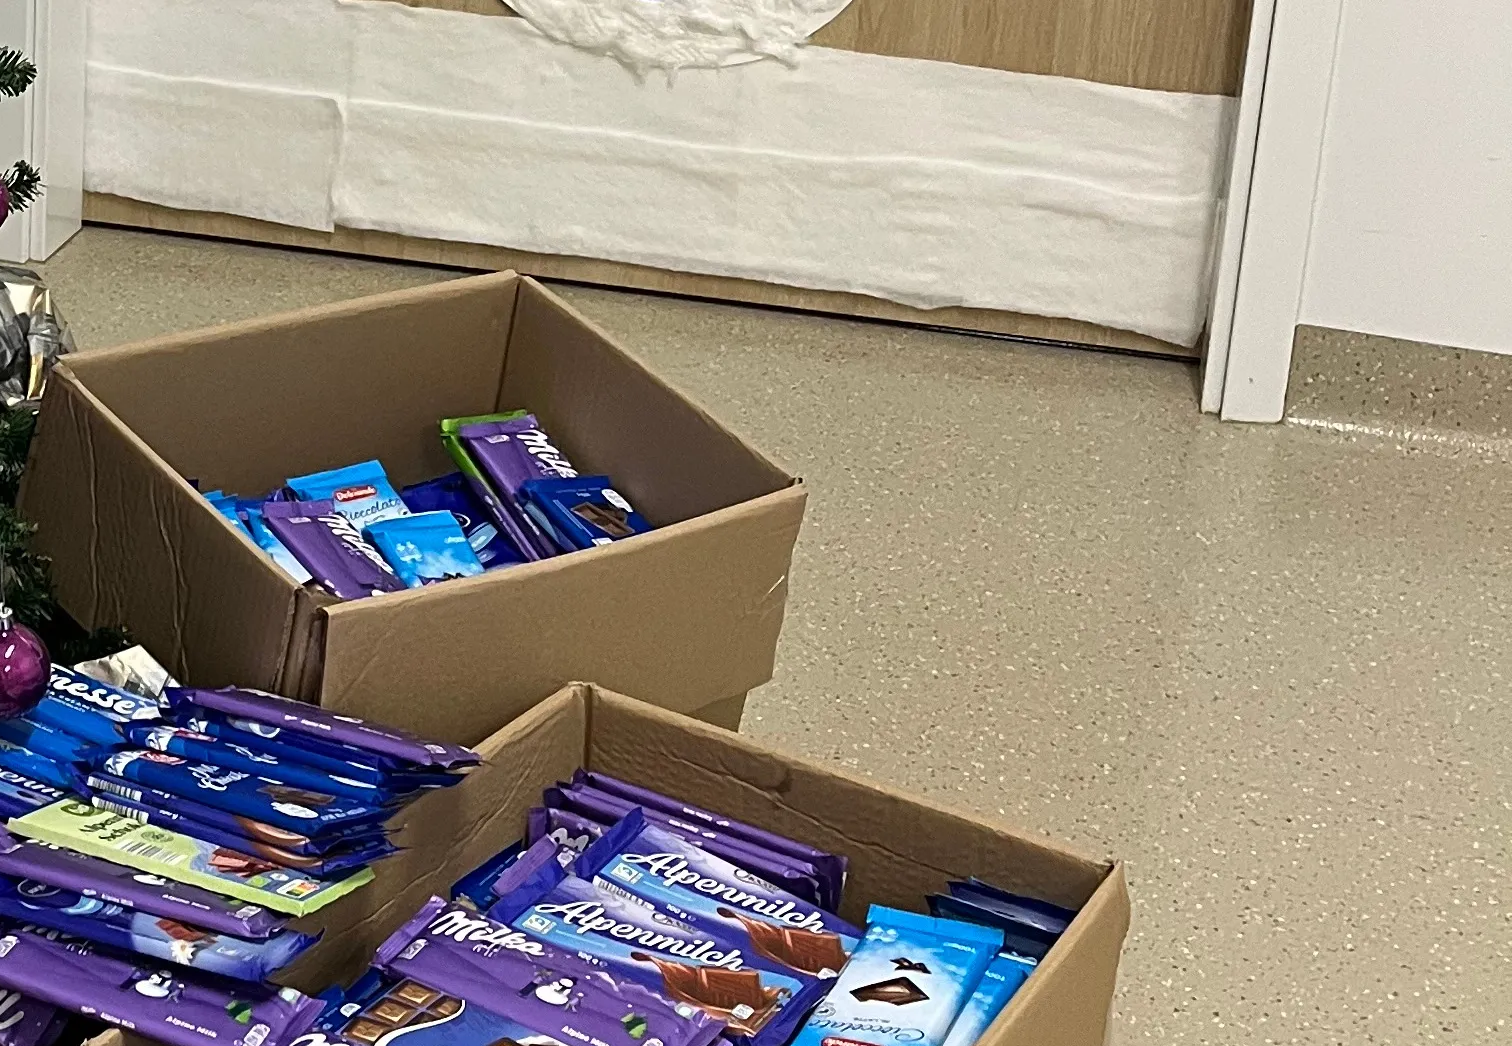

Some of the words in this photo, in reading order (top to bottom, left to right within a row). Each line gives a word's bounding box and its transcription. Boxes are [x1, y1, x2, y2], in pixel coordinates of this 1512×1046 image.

[516, 429, 579, 478] Milk
[621, 852, 825, 935] Alpenmilch
[428, 911, 545, 956] Milka
[534, 900, 745, 972] Alpenmilch
